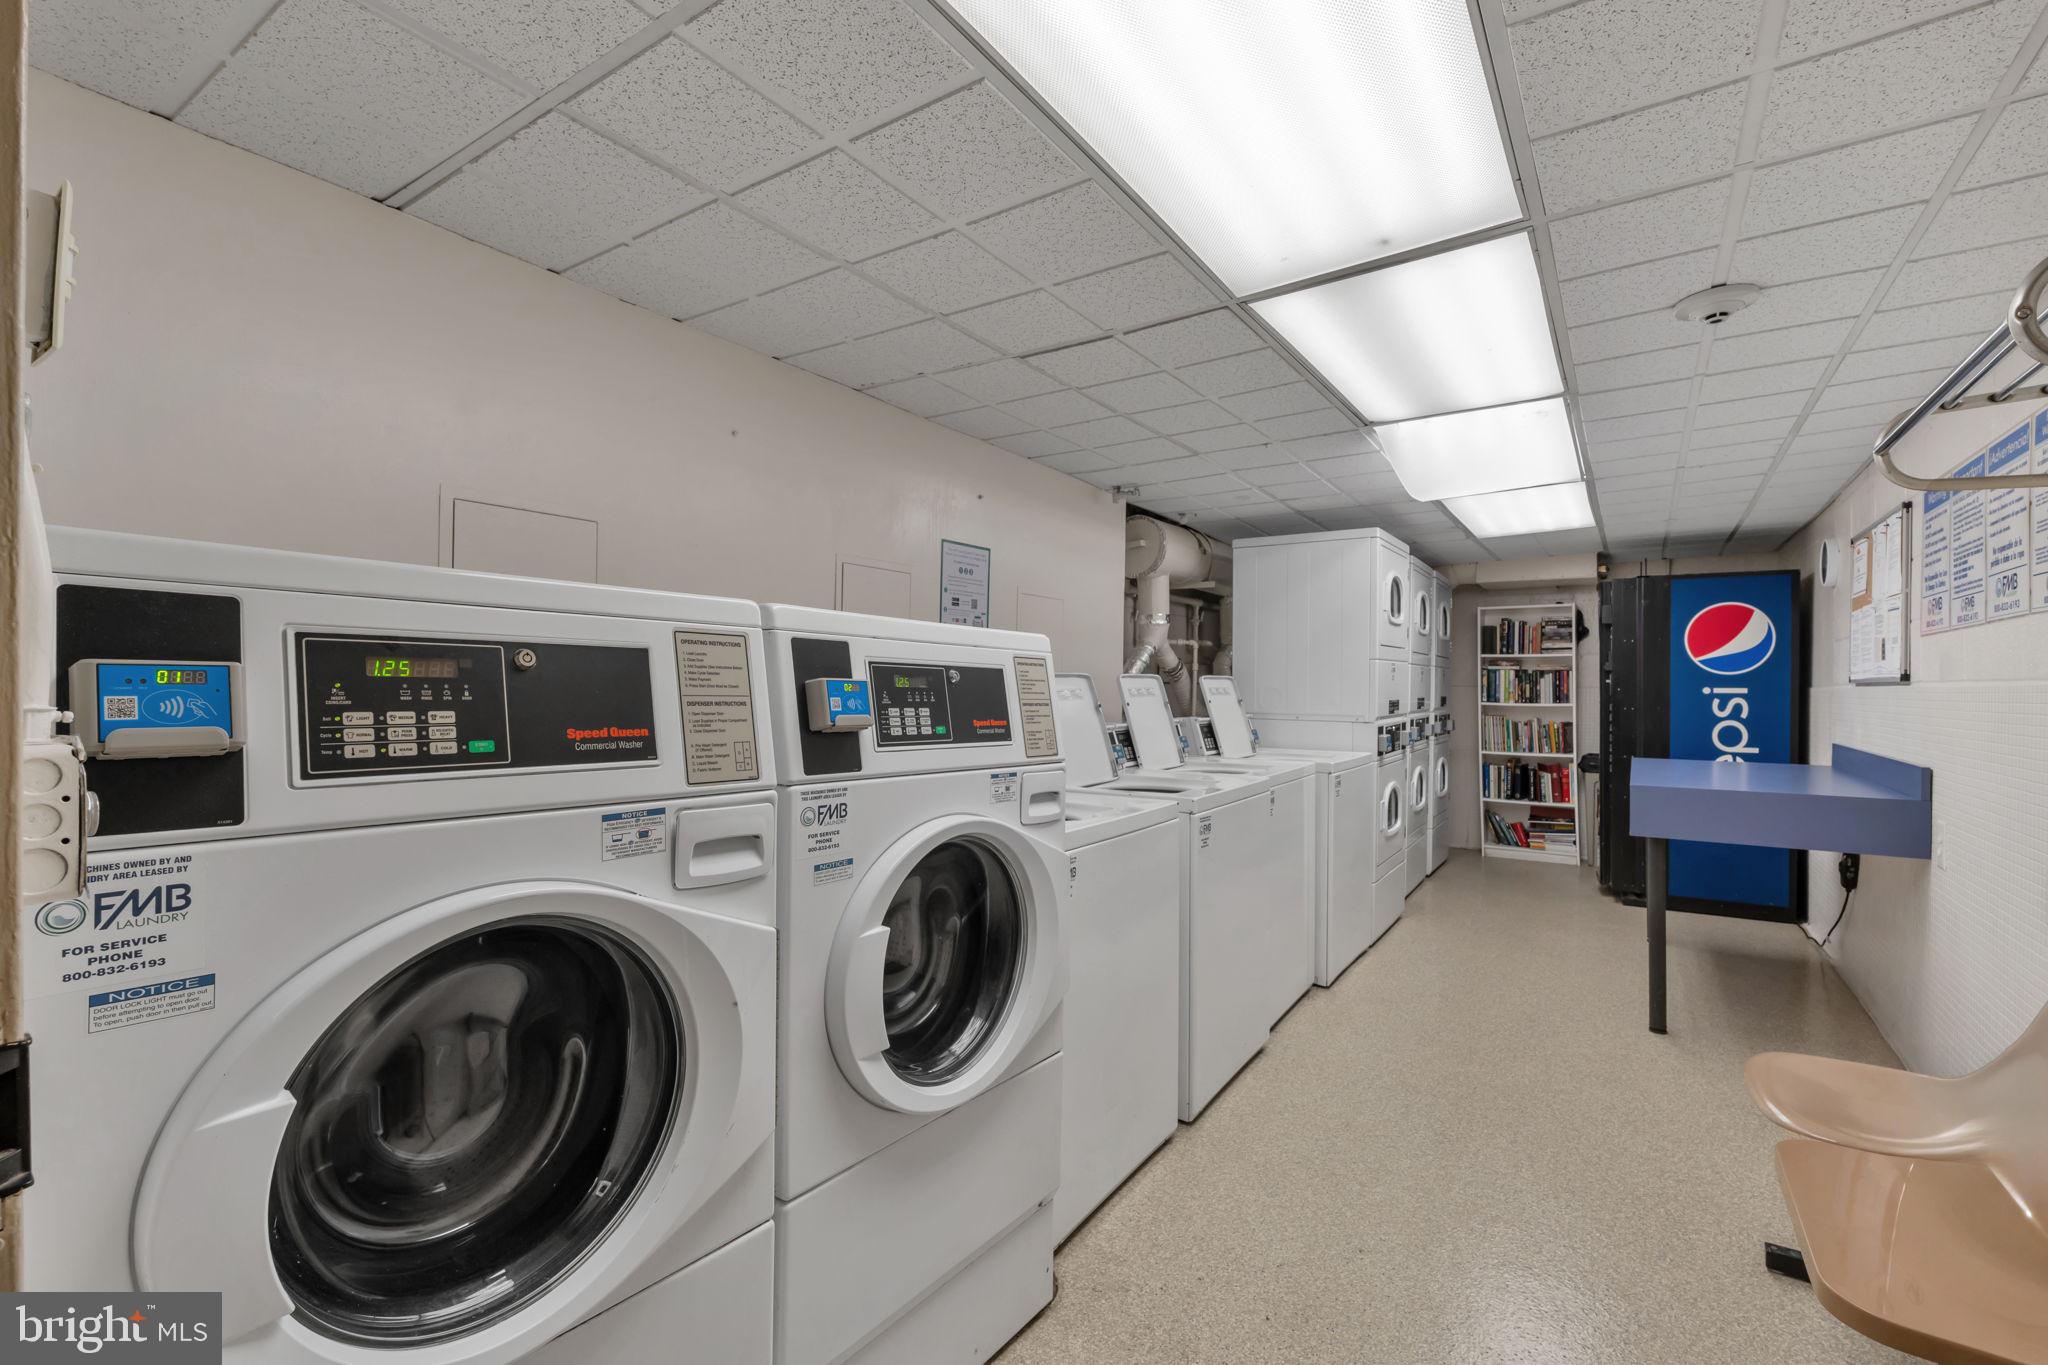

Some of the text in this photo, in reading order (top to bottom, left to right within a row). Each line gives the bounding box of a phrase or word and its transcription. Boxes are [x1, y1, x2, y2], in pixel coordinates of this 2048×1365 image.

[2002, 572, 2018, 597] FMB
[156, 670, 182, 684] 01
[374, 660, 410, 677] 1.25
[844, 684, 852, 692] 02
[566, 726, 649, 740] Speed Queen
[1702, 686, 1760, 763] psi
[575, 740, 643, 750] Commercial Washer
[622, 811, 647, 819] NOTICE
[818, 803, 847, 825] FMB
[86, 863, 120, 873] CHINES
[124, 859, 156, 870] OWNED
[159, 857, 171, 866] BY
[113, 871, 137, 880] AREA
[140, 867, 174, 877] LEASED
[820, 860, 848, 870] NOTICE
[94, 883, 192, 930] FMB
[116, 911, 189, 930] LAUNDRY
[62, 934, 168, 958] FOR SERVICE
[87, 949, 143, 966] PHONE
[62, 958, 166, 982] 800-832-6193
[109, 978, 200, 1002] NOTICE
[93, 1012, 117, 1021] before
[118, 1005, 156, 1017] attempting
[166, 999, 183, 1008] open
[94, 1005, 118, 1014] DOOR
[120, 1001, 142, 1010] LOCK
[144, 997, 166, 1006] LIGHT
[126, 1013, 144, 1022] push
